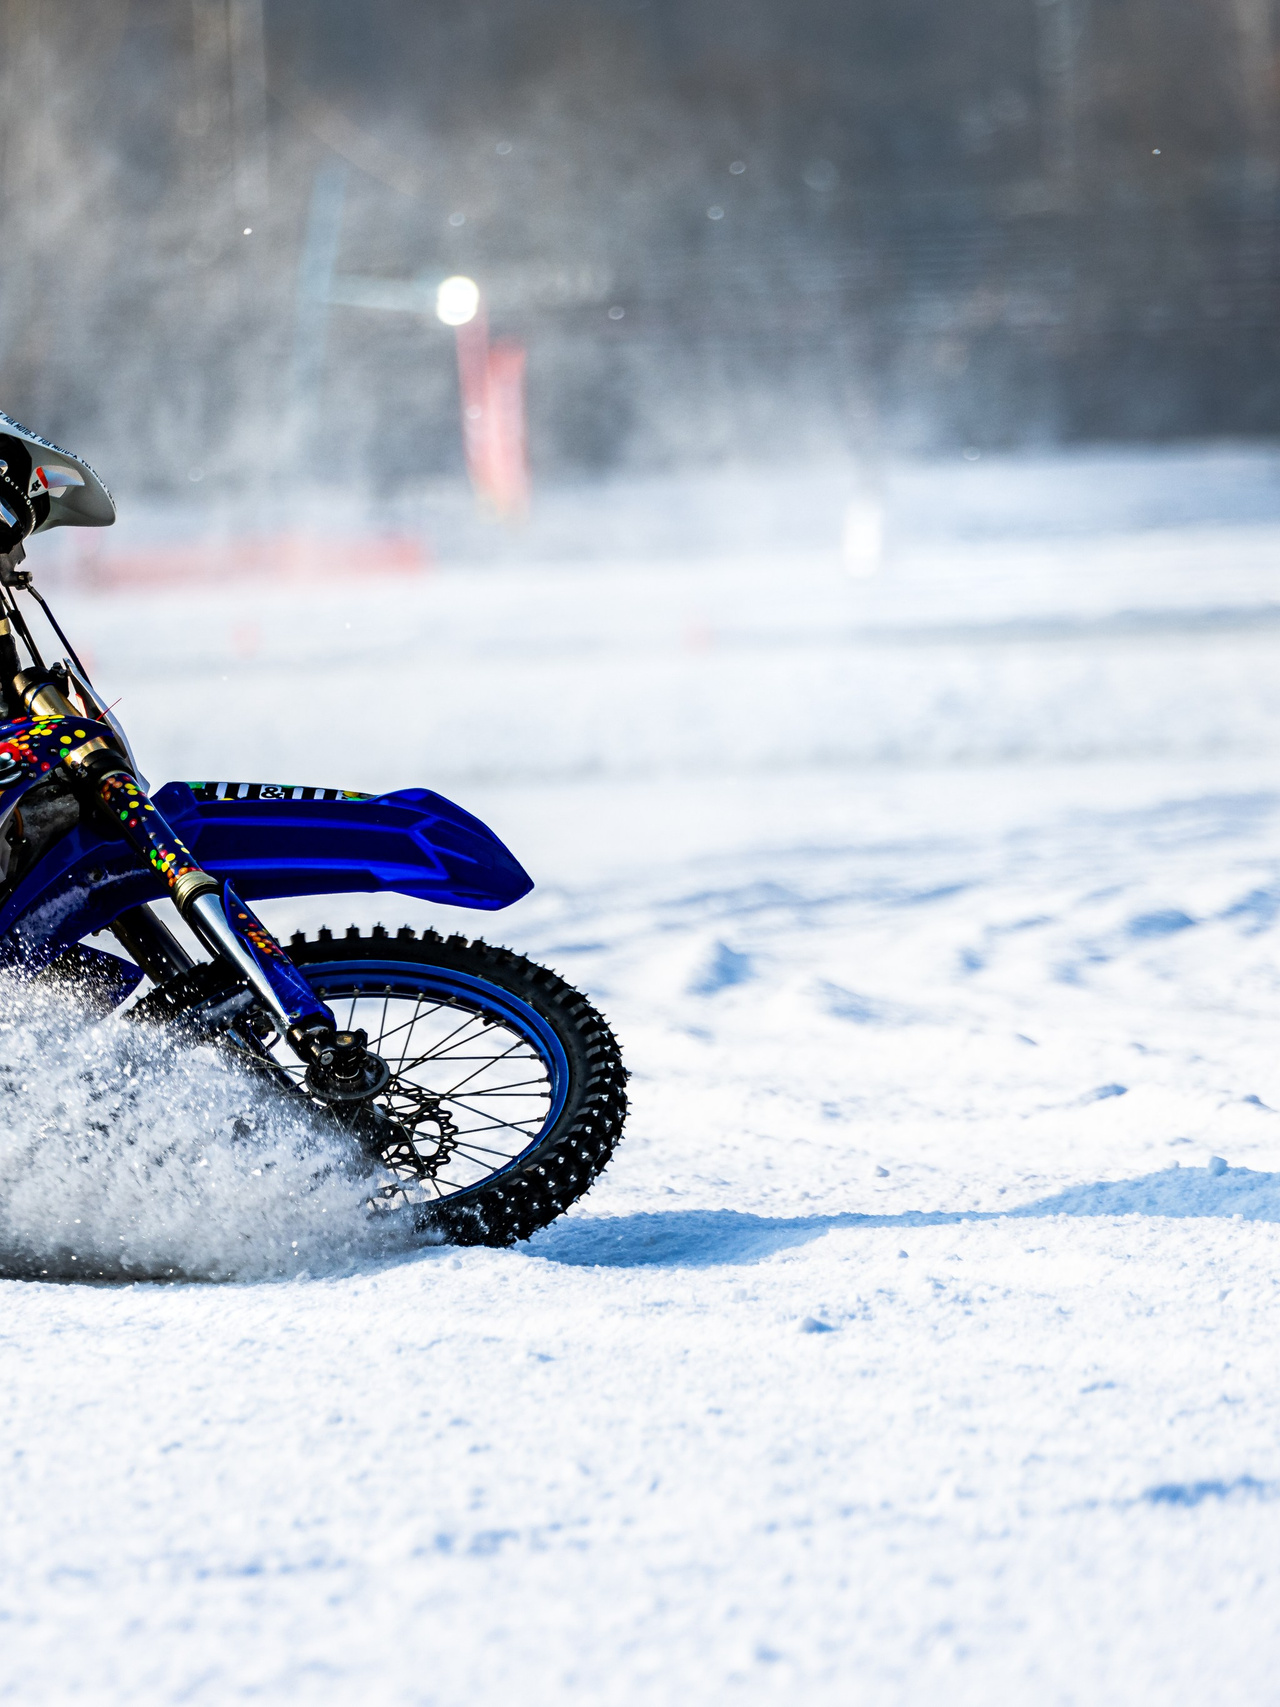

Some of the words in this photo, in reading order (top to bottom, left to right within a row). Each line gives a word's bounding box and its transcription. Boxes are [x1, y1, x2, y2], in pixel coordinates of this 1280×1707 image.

[3, 415, 16, 426] FOX
[13, 422, 38, 440] MOTO-X
[38, 437, 51, 447] FOX
